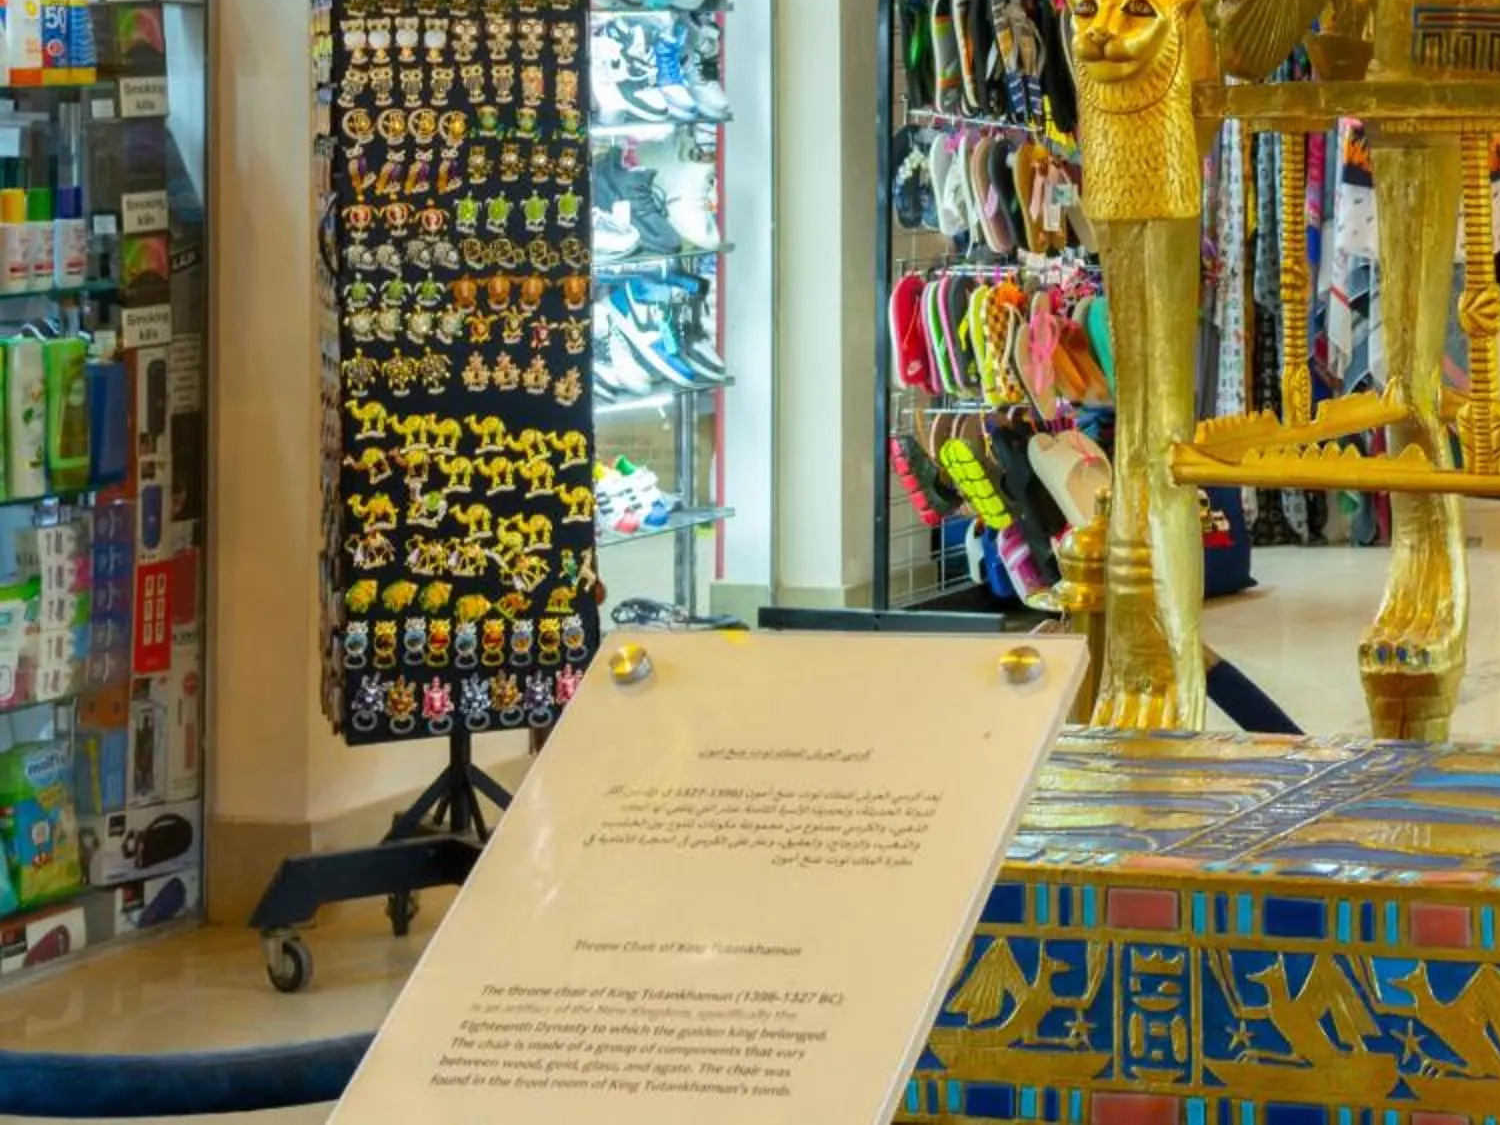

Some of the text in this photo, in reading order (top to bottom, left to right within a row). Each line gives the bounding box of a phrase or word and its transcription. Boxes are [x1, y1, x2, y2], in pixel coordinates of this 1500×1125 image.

[481, 985, 505, 997] The
[554, 986, 588, 998] chair
[589, 987, 607, 998] of
[607, 987, 639, 1002] King
[610, 1024, 651, 1036] which
[653, 1025, 675, 1037] the
[451, 1036, 475, 1049] The
[477, 1038, 511, 1050] chair
[527, 1040, 564, 1051] made
[566, 1041, 584, 1052] of
[639, 1043, 656, 1055] of
[744, 1046, 773, 1058] that
[776, 1049, 806, 1061] vary
[699, 1062, 724, 1074] The
[764, 1068, 791, 1078] was
[488, 1076, 511, 1087] the
[590, 1078, 607, 1090] of
[608, 1080, 640, 1094] King
